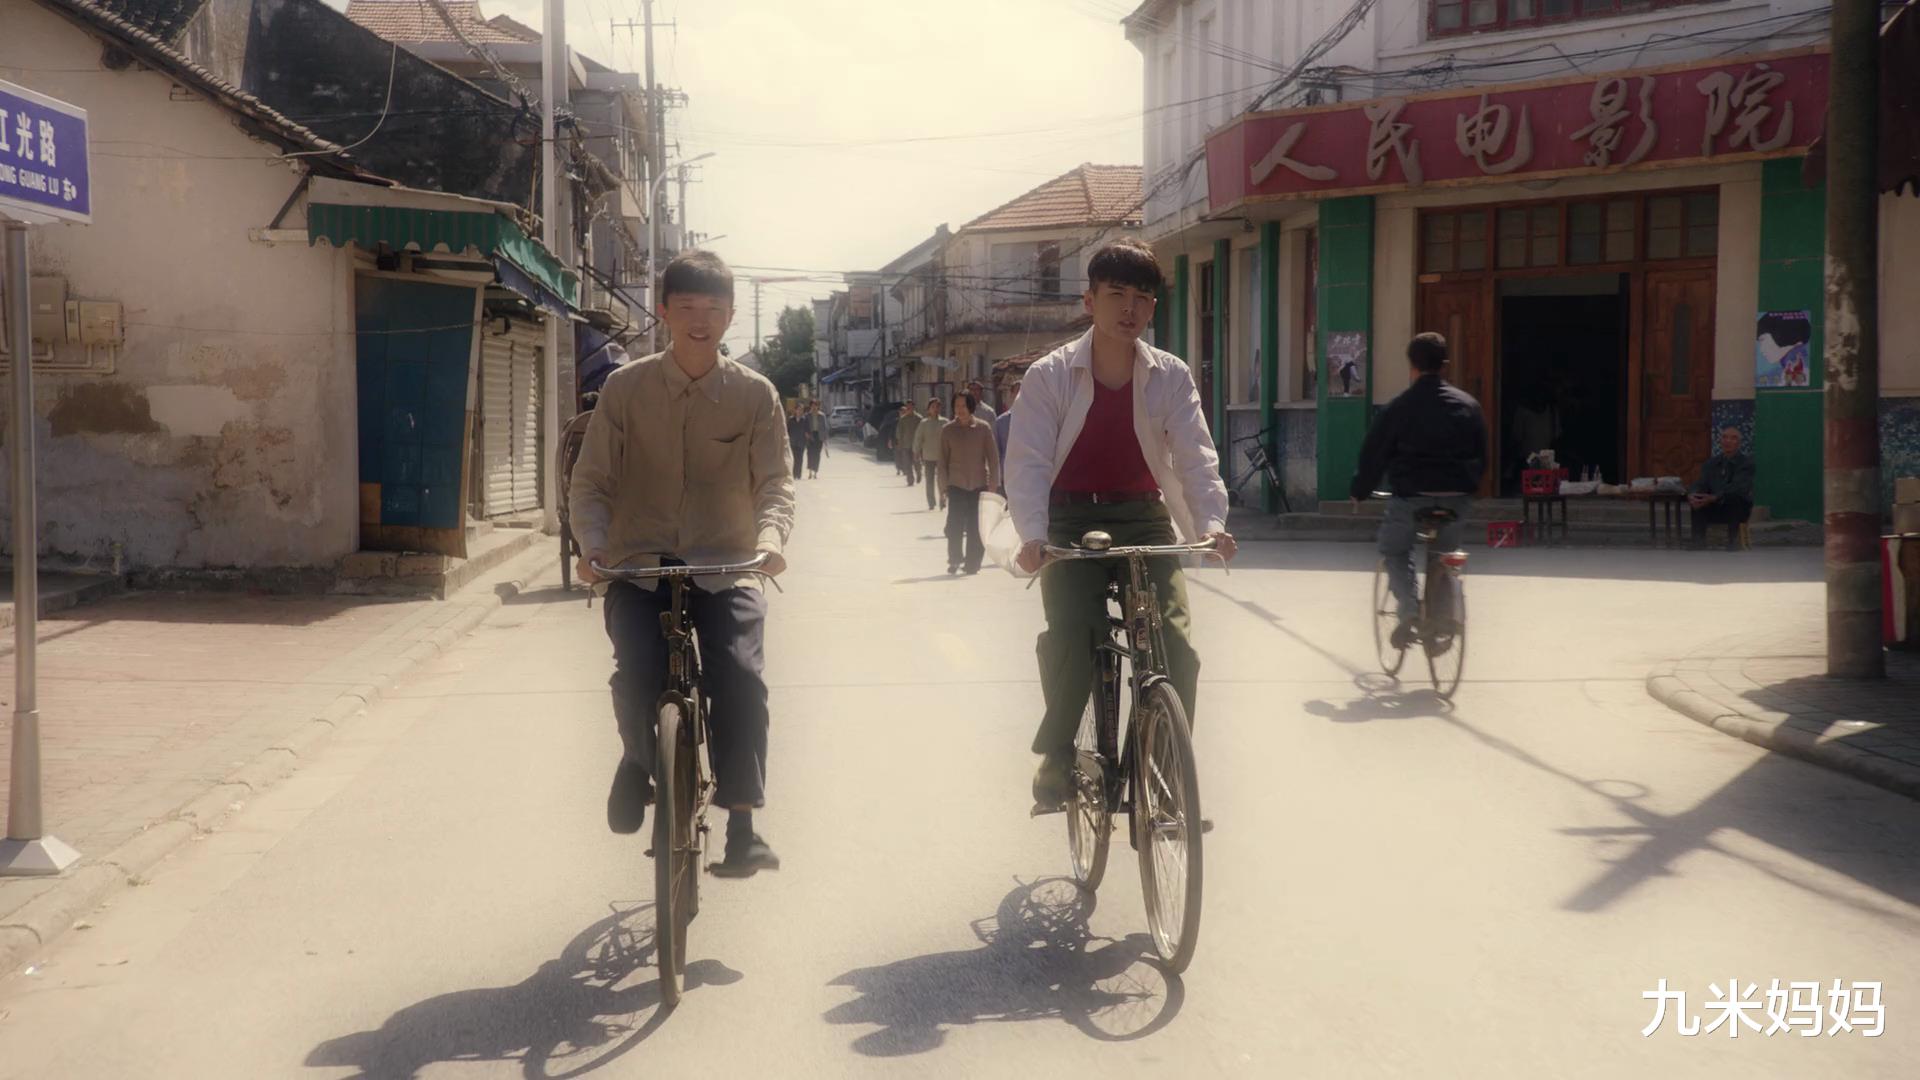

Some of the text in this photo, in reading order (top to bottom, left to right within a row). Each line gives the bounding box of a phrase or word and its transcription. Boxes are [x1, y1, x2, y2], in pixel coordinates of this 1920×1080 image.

[1250, 63, 1794, 185] 人民电影院
[19, 168, 47, 192] GUANG
[48, 176, 59, 195] LU
